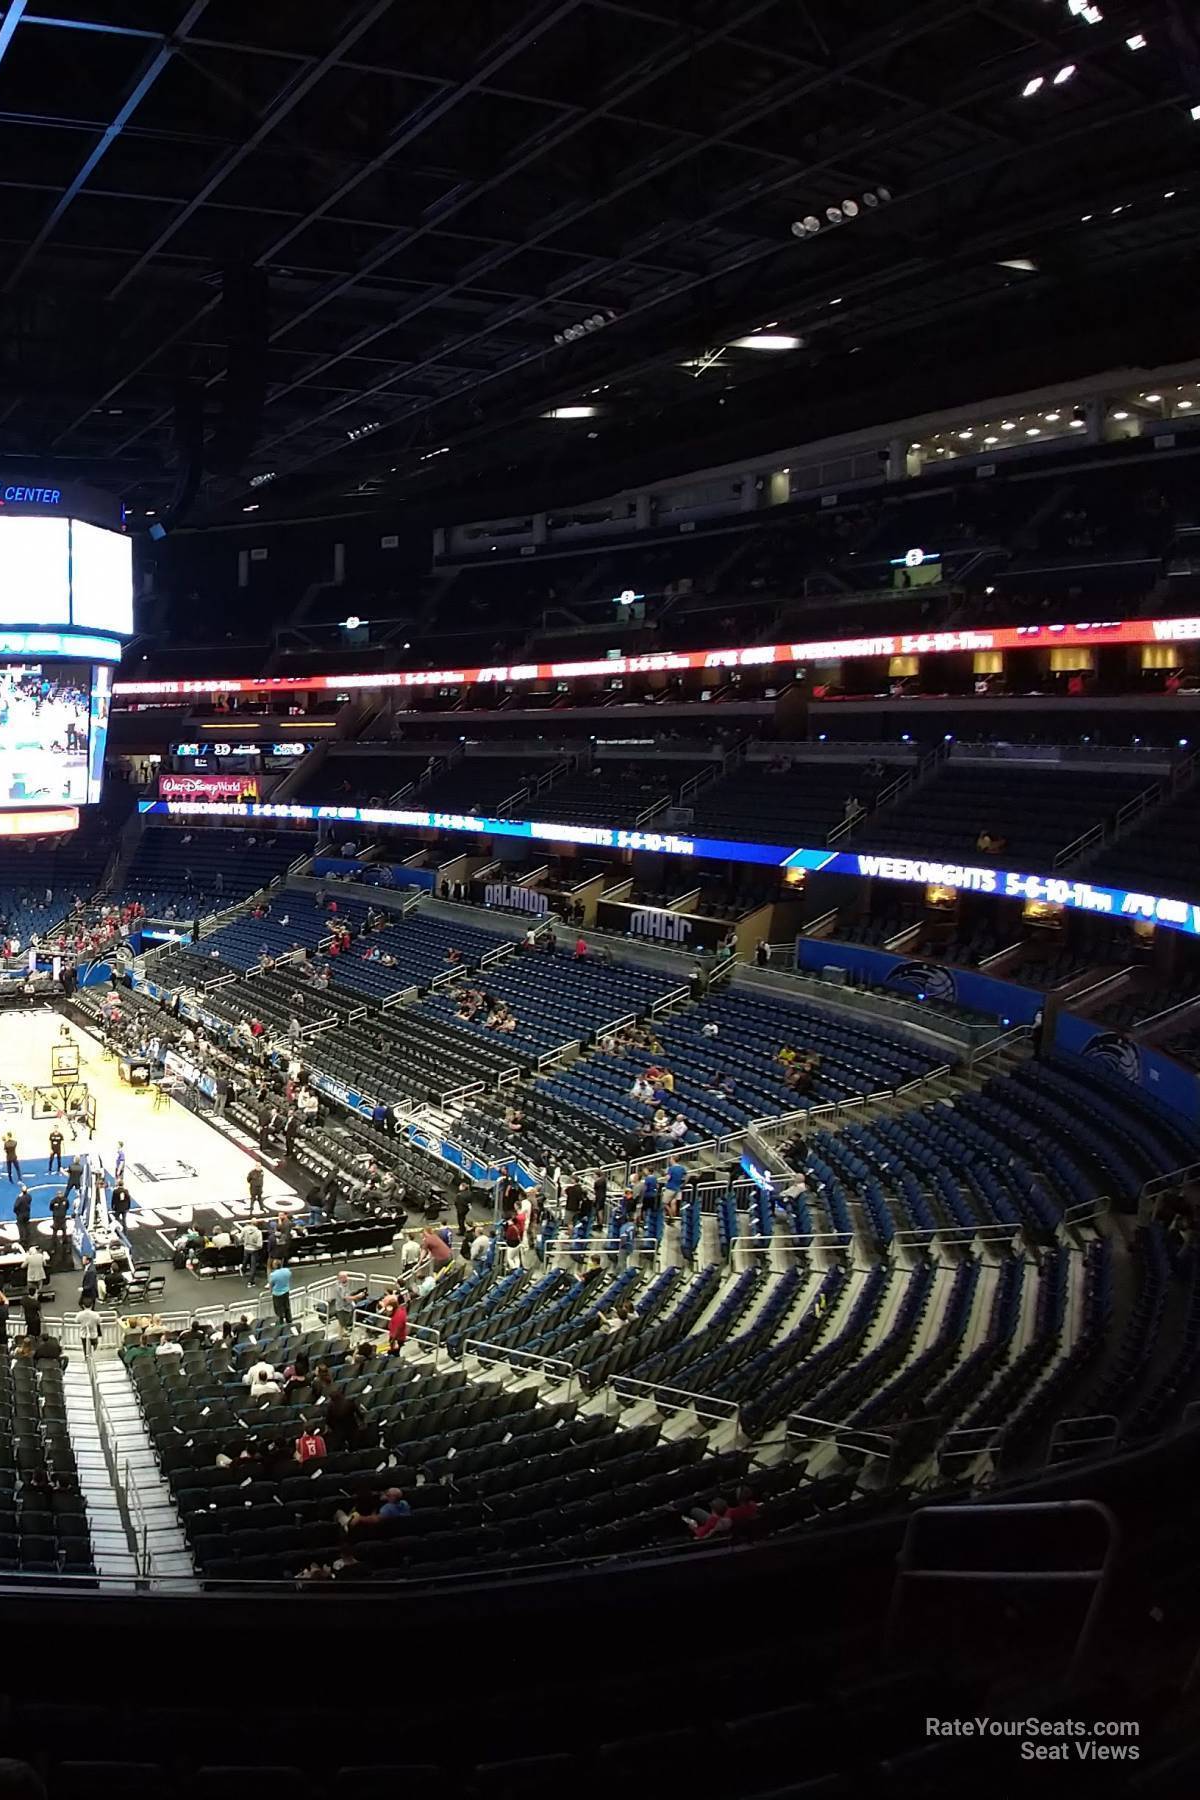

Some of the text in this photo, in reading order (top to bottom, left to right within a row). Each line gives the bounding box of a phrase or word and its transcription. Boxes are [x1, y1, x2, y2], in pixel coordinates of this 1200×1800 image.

[4, 486, 60, 504] CENTER
[163, 778, 241, 795] Walt Disney World
[857, 854, 997, 892] WEEKNIGHTS
[484, 884, 549, 913] ORLANDO
[630, 909, 693, 942] MAGIC
